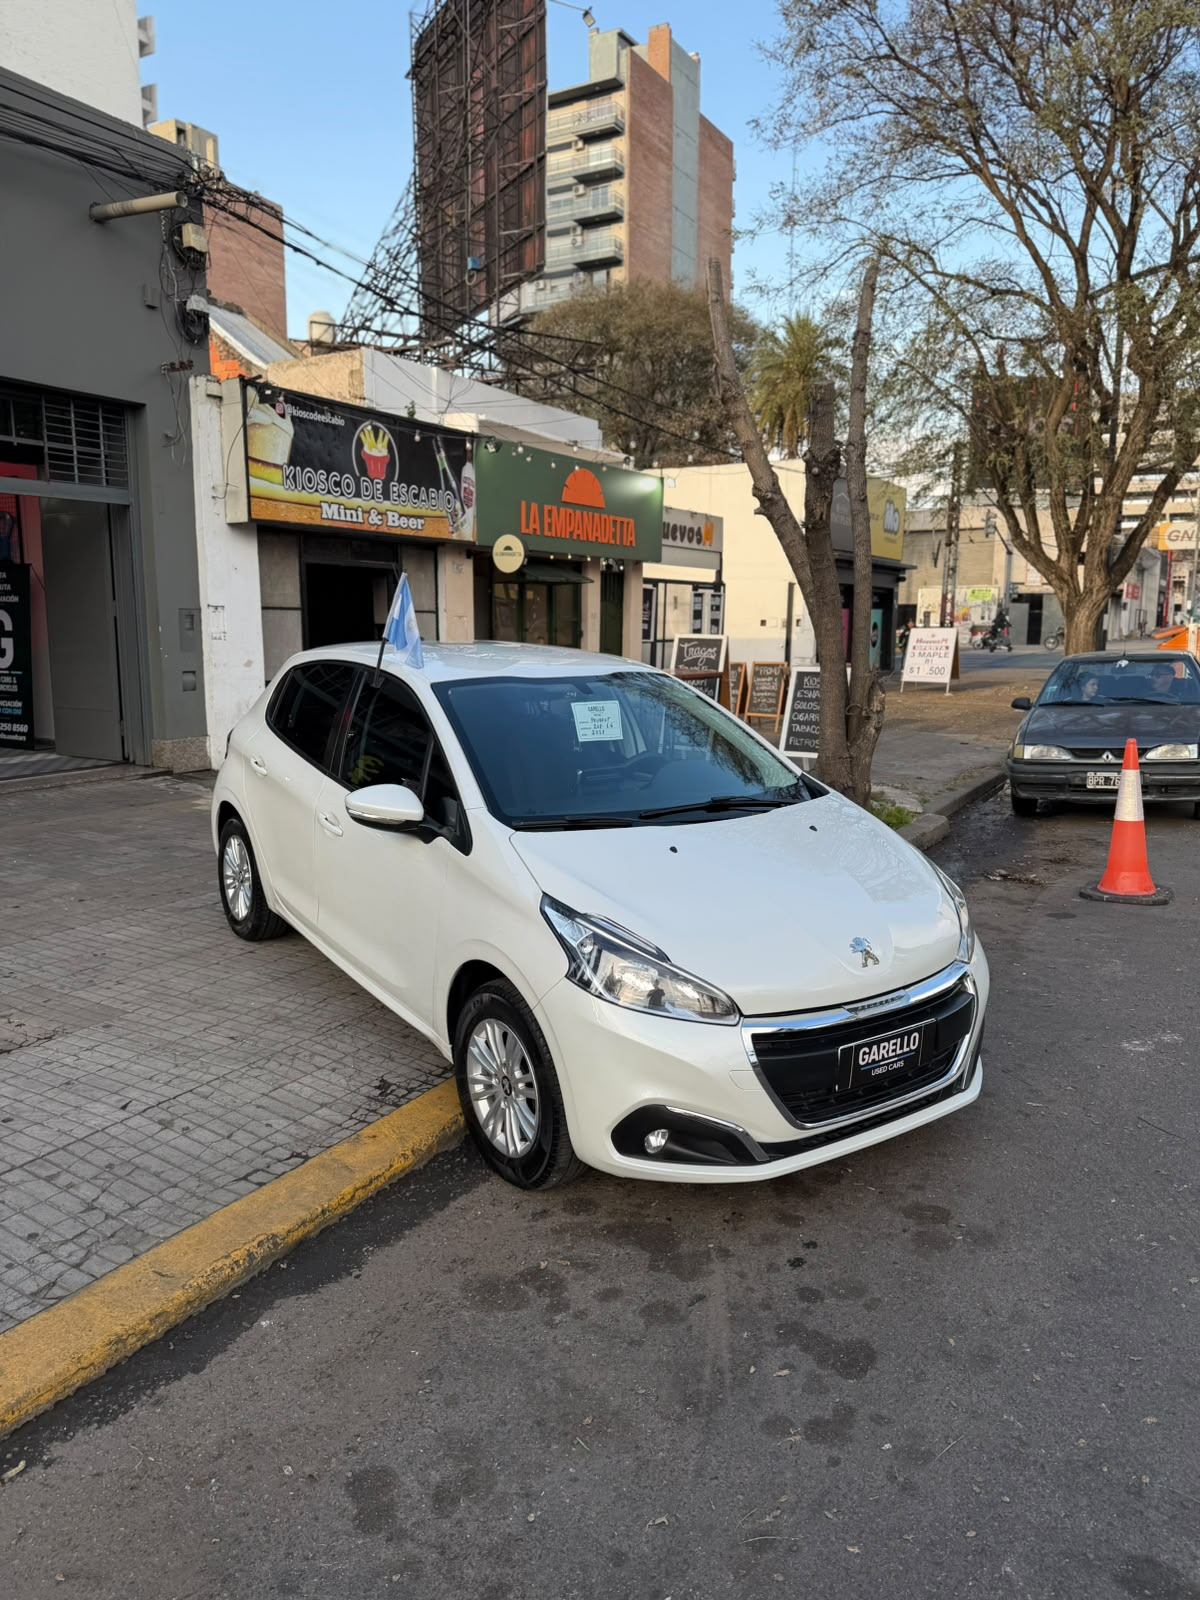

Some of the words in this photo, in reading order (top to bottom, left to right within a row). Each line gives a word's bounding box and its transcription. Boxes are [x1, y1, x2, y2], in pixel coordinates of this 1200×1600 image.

[285, 404, 345, 427] @kioscodeescabio
[283, 465, 354, 498] KIOSCO
[360, 477, 384, 502] DE
[389, 482, 456, 512] ESCABIO
[320, 501, 363, 524] Mini
[368, 508, 383, 525] &
[387, 510, 425, 530] Beer
[520, 500, 541, 537] LA
[543, 504, 636, 547] EMPANADETTA
[680, 641, 717, 666] Tragos
[794, 701, 819, 710] GOLOS
[1088, 775, 1104, 786] BPR
[858, 1033, 919, 1065] GARELLO
[871, 1064, 888, 1076] USED
[888, 1060, 905, 1071] CARS
